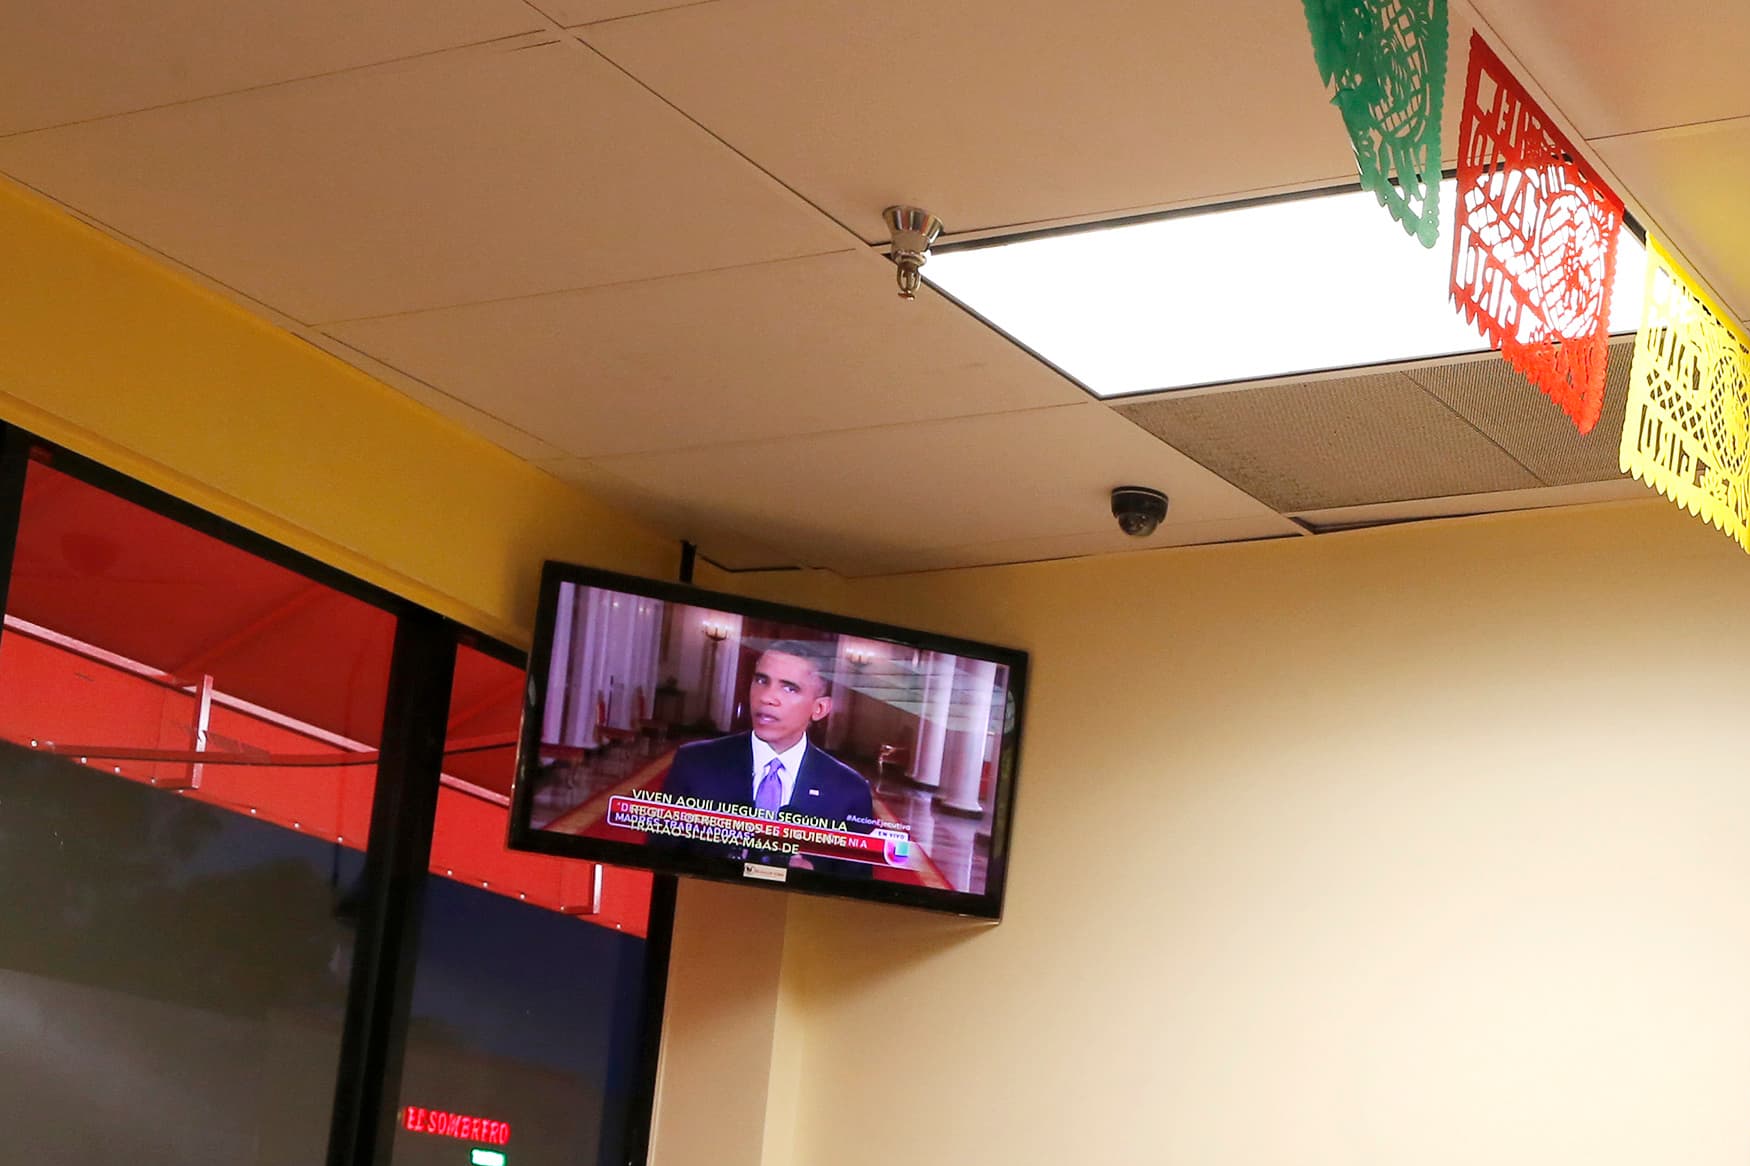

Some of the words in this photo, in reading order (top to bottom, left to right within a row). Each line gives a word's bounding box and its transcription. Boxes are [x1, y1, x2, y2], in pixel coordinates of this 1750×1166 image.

[615, 812, 661, 827] MADRES
[632, 788, 672, 804] VIVEN
[717, 802, 774, 820] JUEGUEN
[832, 820, 848, 832] LA
[685, 829, 695, 839] SI
[699, 831, 739, 846] LLEVA
[782, 842, 800, 855] DE
[427, 1110, 510, 1145] SOMBRERO
